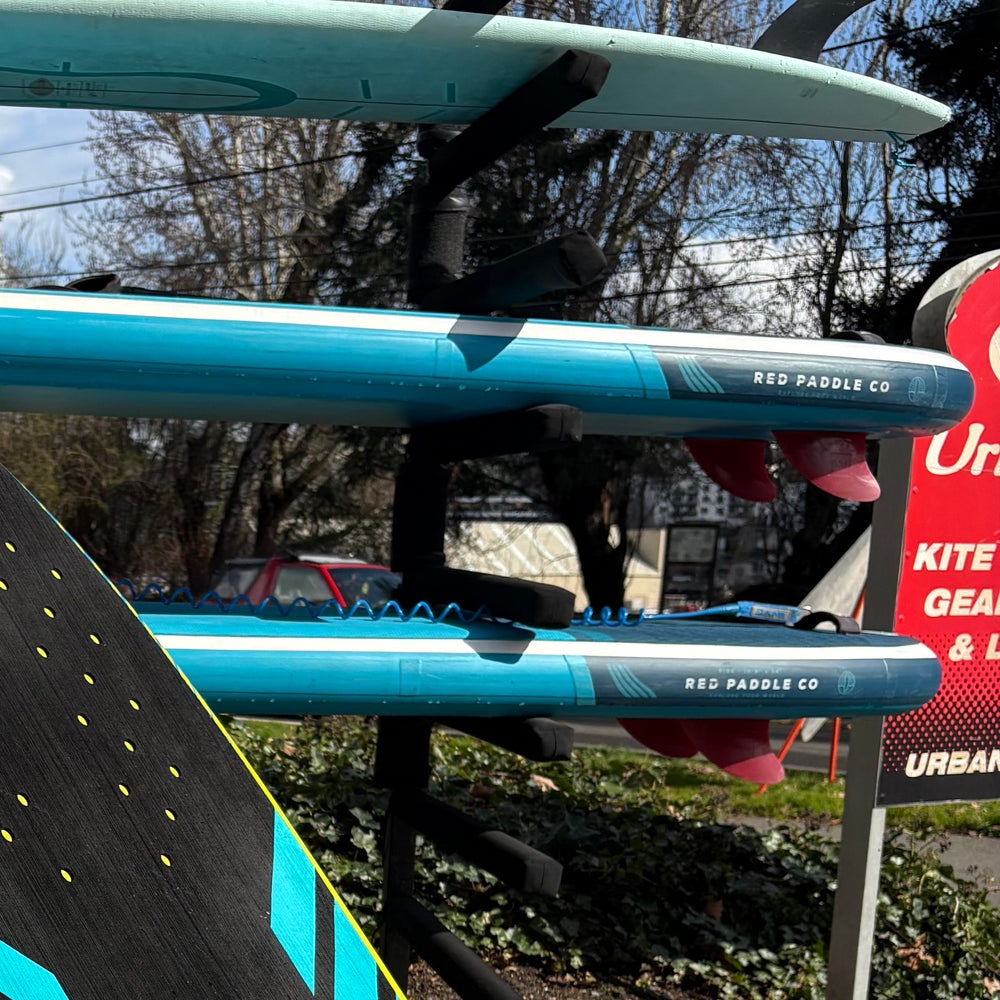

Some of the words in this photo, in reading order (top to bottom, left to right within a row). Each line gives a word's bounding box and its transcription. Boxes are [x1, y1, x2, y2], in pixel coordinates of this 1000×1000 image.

[753, 371, 788, 386] RED
[796, 374, 862, 391] PADDLE
[869, 380, 890, 392] CO
[925, 423, 1000, 477] Ur
[912, 543, 997, 571] KITE
[923, 587, 1000, 617] GEA
[948, 633, 975, 662] &
[685, 678, 719, 690] RED
[726, 678, 792, 691] PADDLE
[798, 678, 819, 690] CO
